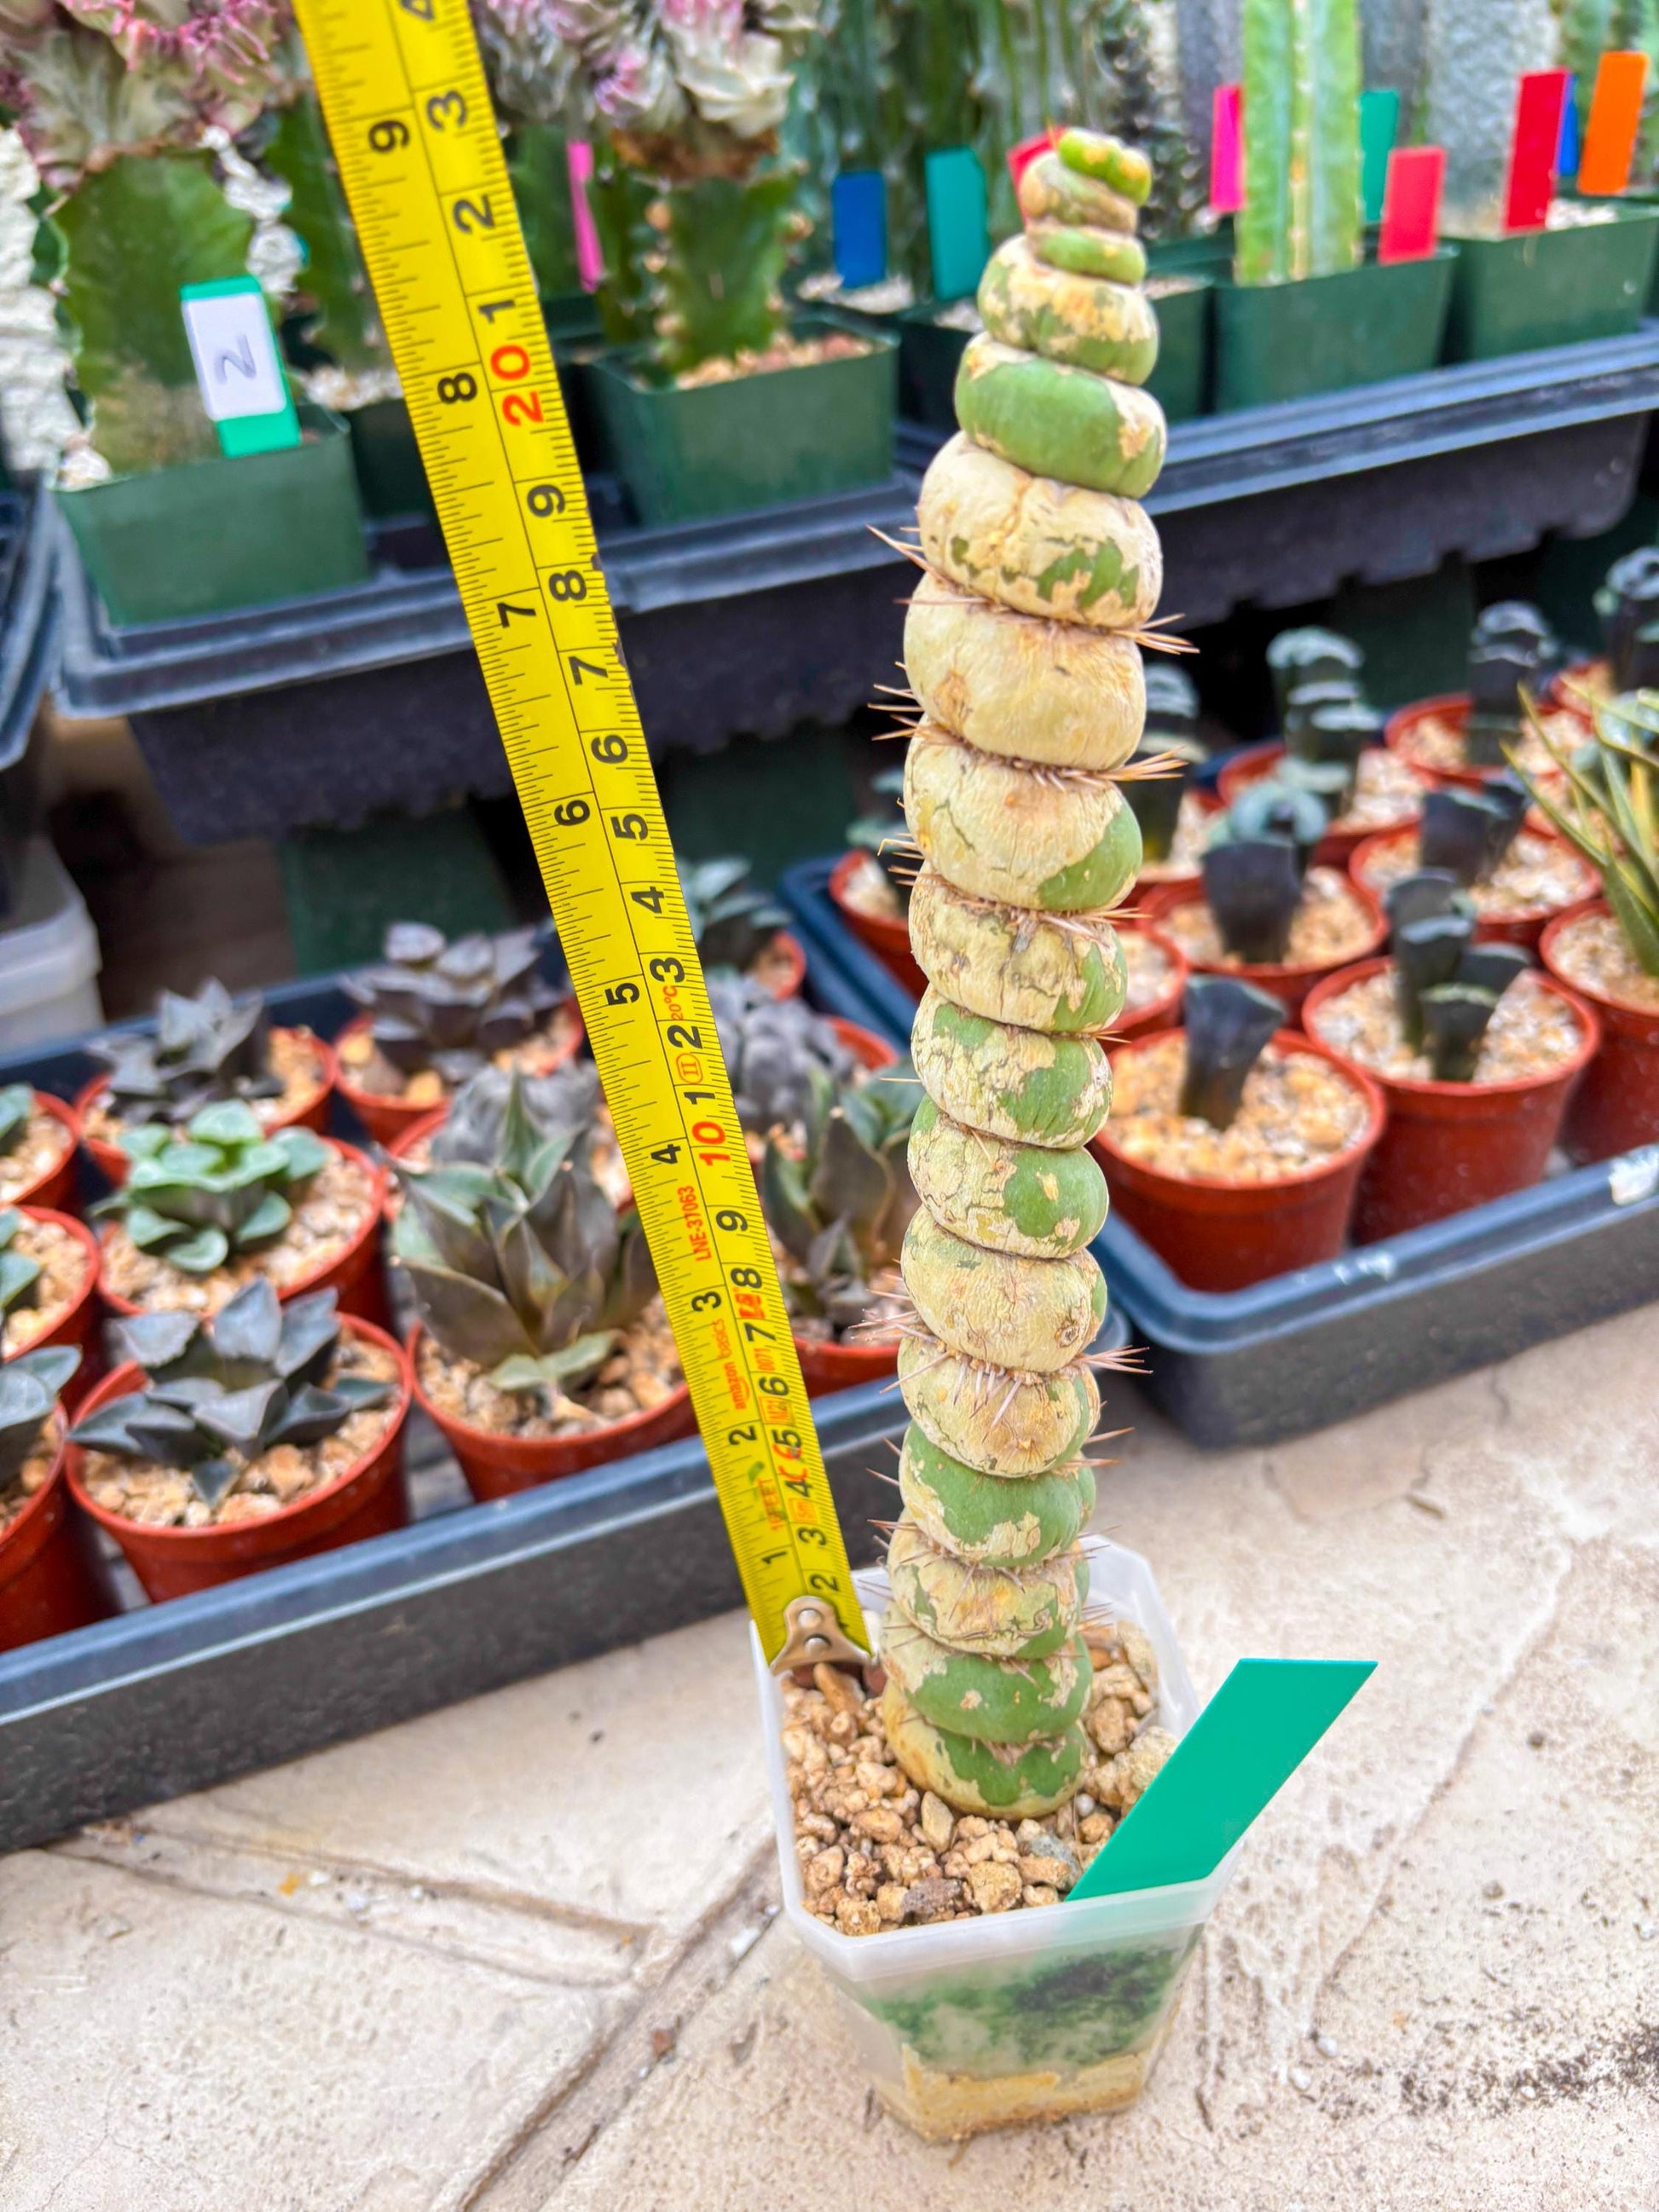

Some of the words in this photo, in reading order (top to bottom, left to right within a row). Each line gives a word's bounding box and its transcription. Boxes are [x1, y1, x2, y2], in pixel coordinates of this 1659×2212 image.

[427, 90, 468, 130] 3
[368, 120, 410, 152] 9
[454, 194, 495, 234] 2
[478, 299, 516, 324] 1
[437, 373, 477, 404] 8
[490, 344, 544, 426] 20
[527, 484, 565, 517] 9
[549, 569, 587, 602] 8
[497, 602, 536, 628] 7
[569, 656, 608, 685] 7
[592, 734, 628, 765] 6
[554, 799, 591, 826] 6
[611, 813, 648, 841] 5
[632, 886, 665, 914] 4
[650, 957, 685, 983] 3
[607, 982, 640, 1005] 5
[668, 1025, 703, 1049] 2
[684, 1091, 716, 1106] 1
[651, 1144, 682, 1164] 4
[692, 1121, 731, 1166] 10
[677, 1186, 712, 1262] LNE-37063
[716, 1210, 749, 1232] 9
[731, 1268, 762, 1289] 8
[691, 1291, 722, 1312] 3
[713, 1318, 732, 1359] basics
[744, 1322, 777, 1342] 7
[724, 1361, 747, 1410] amazon
[759, 1377, 789, 1396] 6
[728, 1425, 757, 1446] 2
[772, 1429, 801, 1449] 5
[785, 1478, 812, 1498] 4
[798, 1527, 827, 1546] 3
[762, 1550, 787, 1565] 1
[810, 1574, 840, 1592] 2
